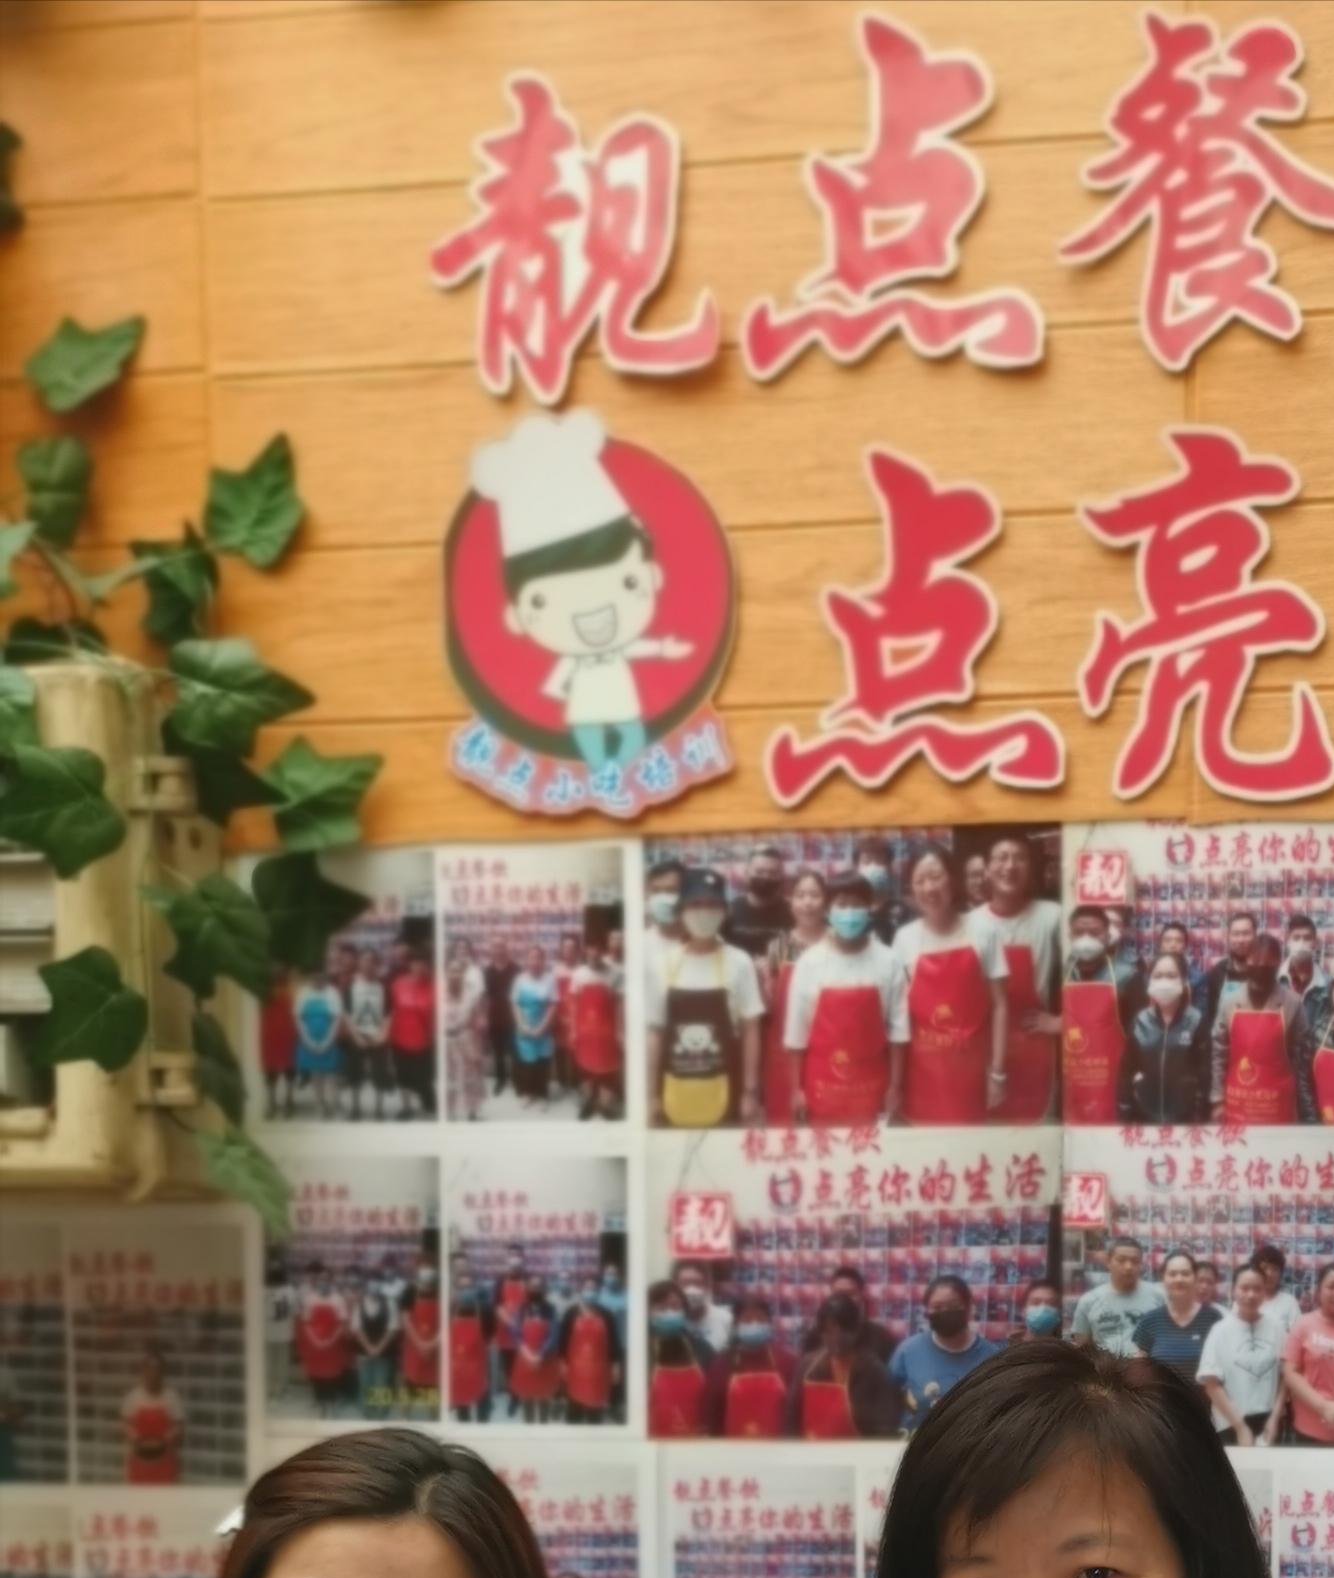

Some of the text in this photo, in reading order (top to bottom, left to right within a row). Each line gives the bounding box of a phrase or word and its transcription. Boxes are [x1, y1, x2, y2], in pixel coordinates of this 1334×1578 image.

[808, 1153, 1046, 1211] 点亮你的生活
